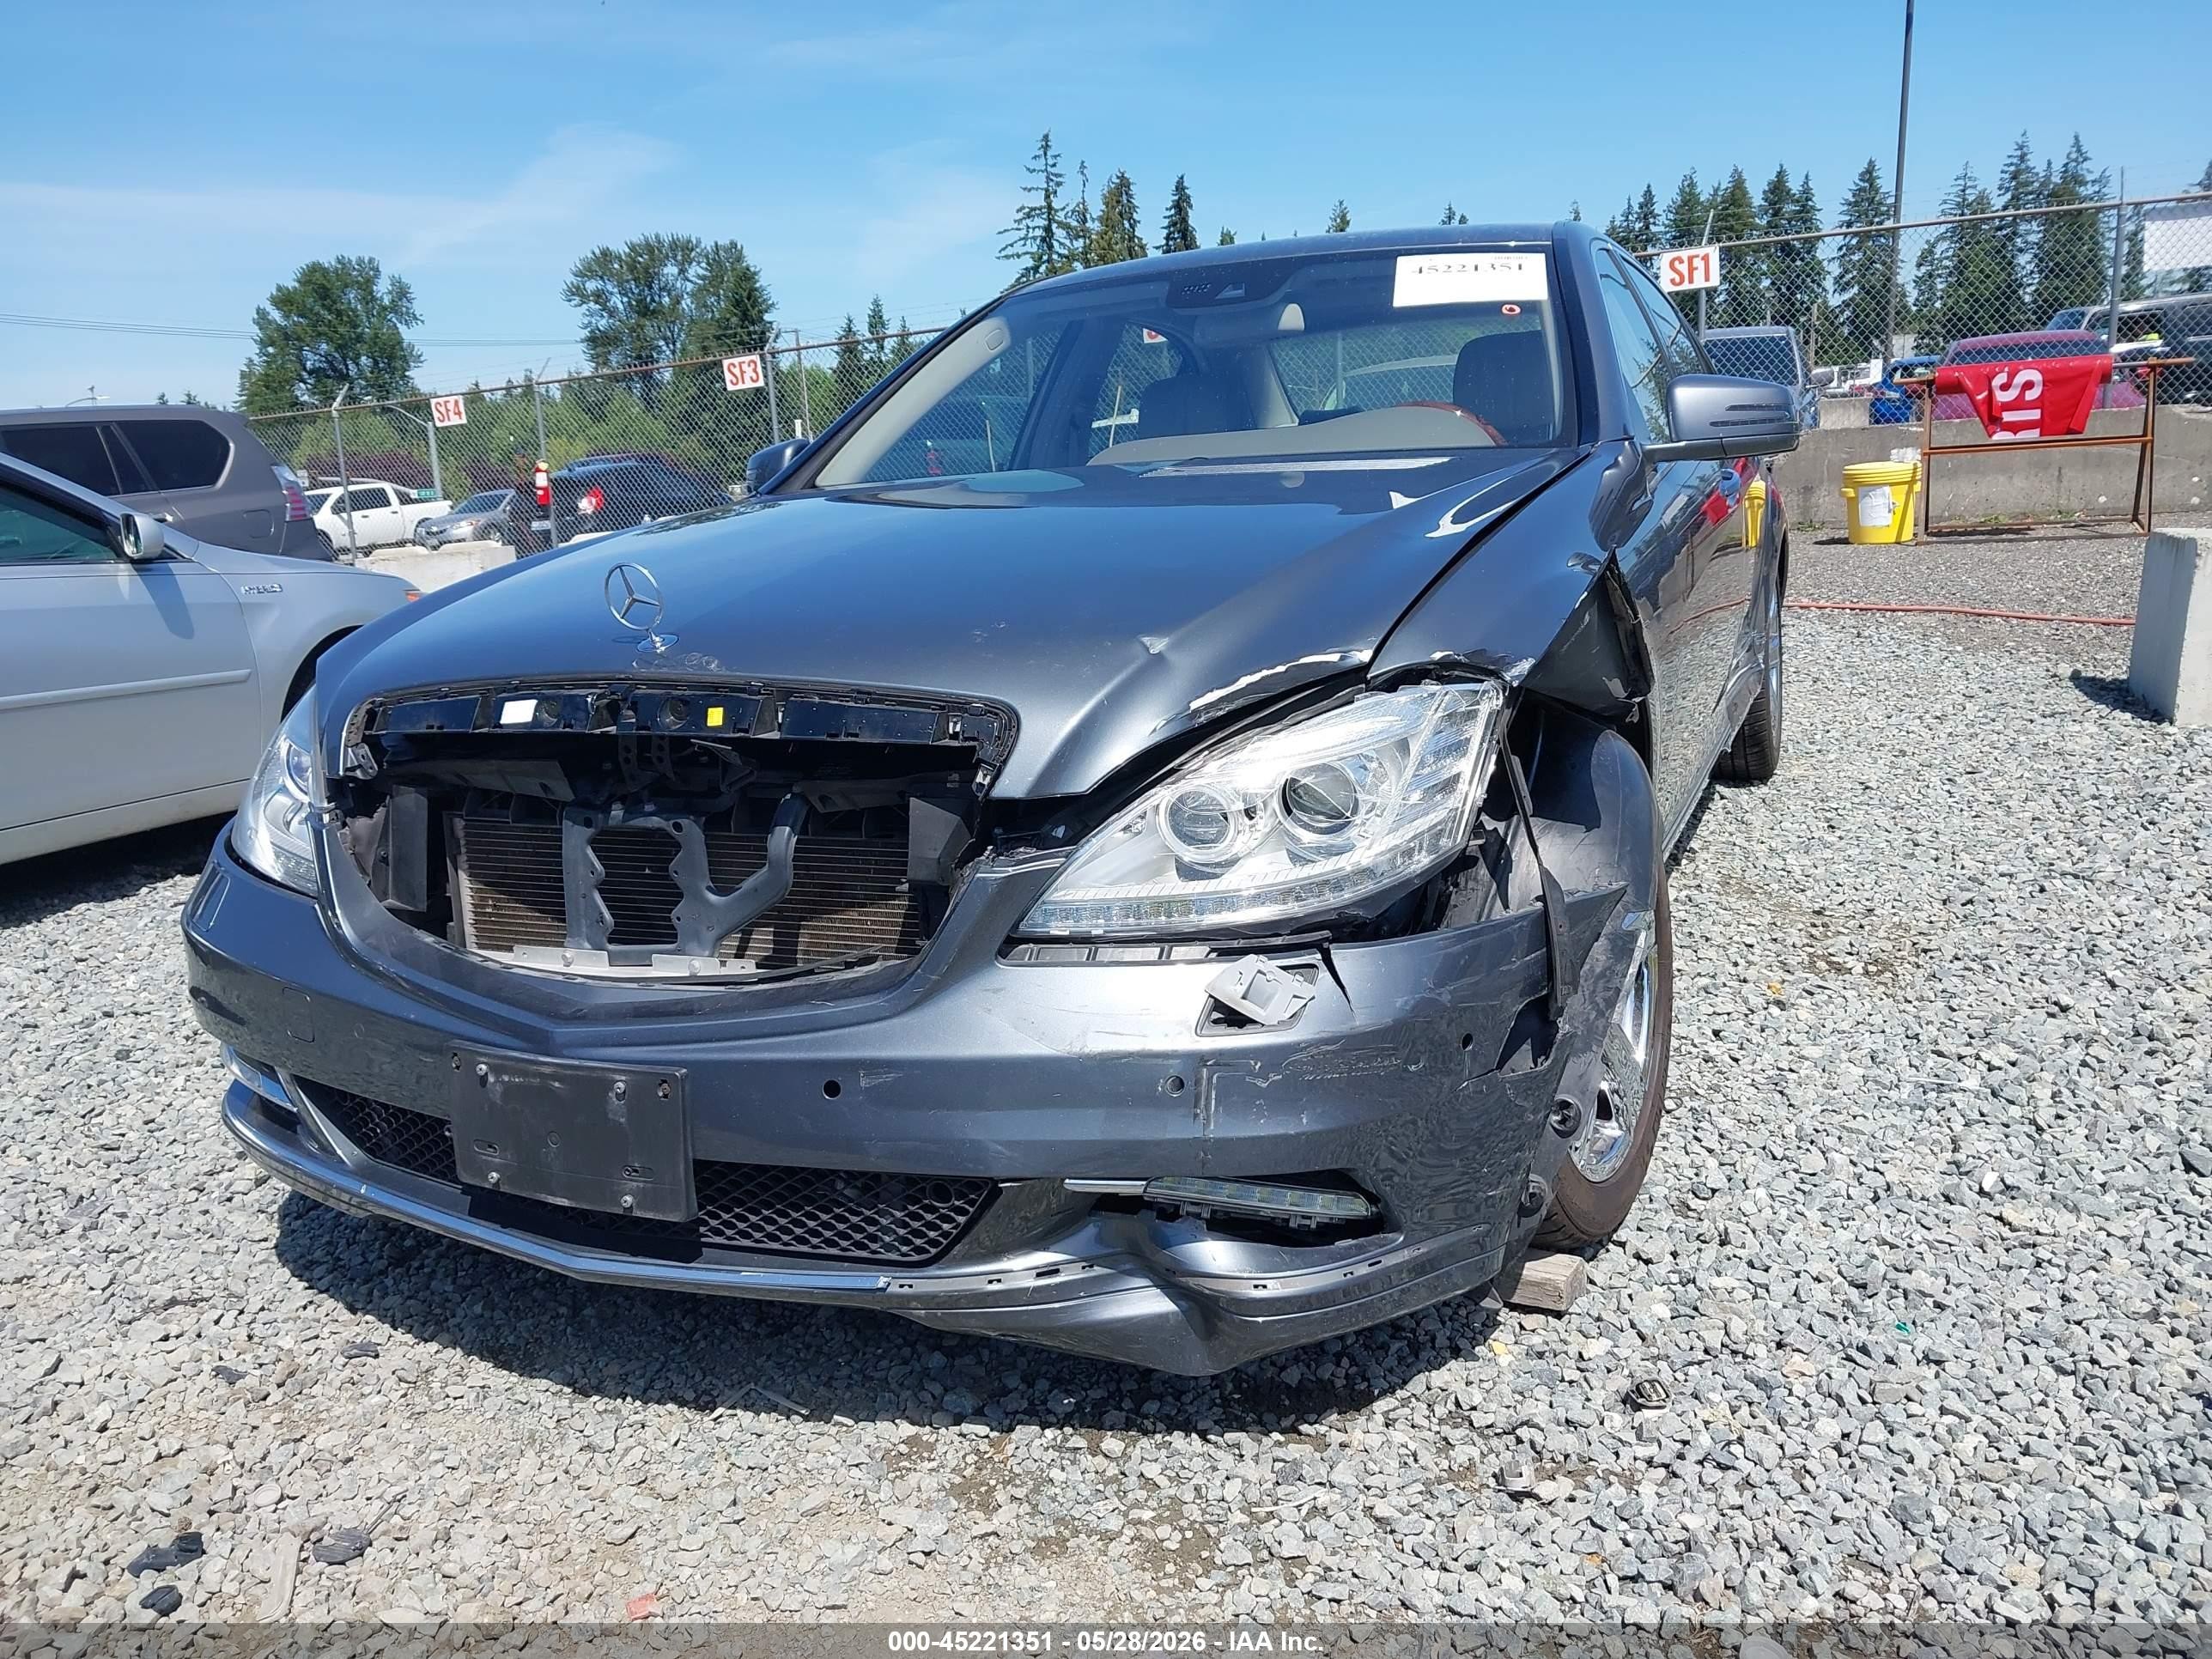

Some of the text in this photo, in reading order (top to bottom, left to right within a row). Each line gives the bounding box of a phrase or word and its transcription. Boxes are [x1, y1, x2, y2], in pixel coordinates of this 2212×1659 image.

[1669, 252, 1710, 286] SF1
[727, 359, 759, 386] SF3
[434, 399, 462, 422] SF4
